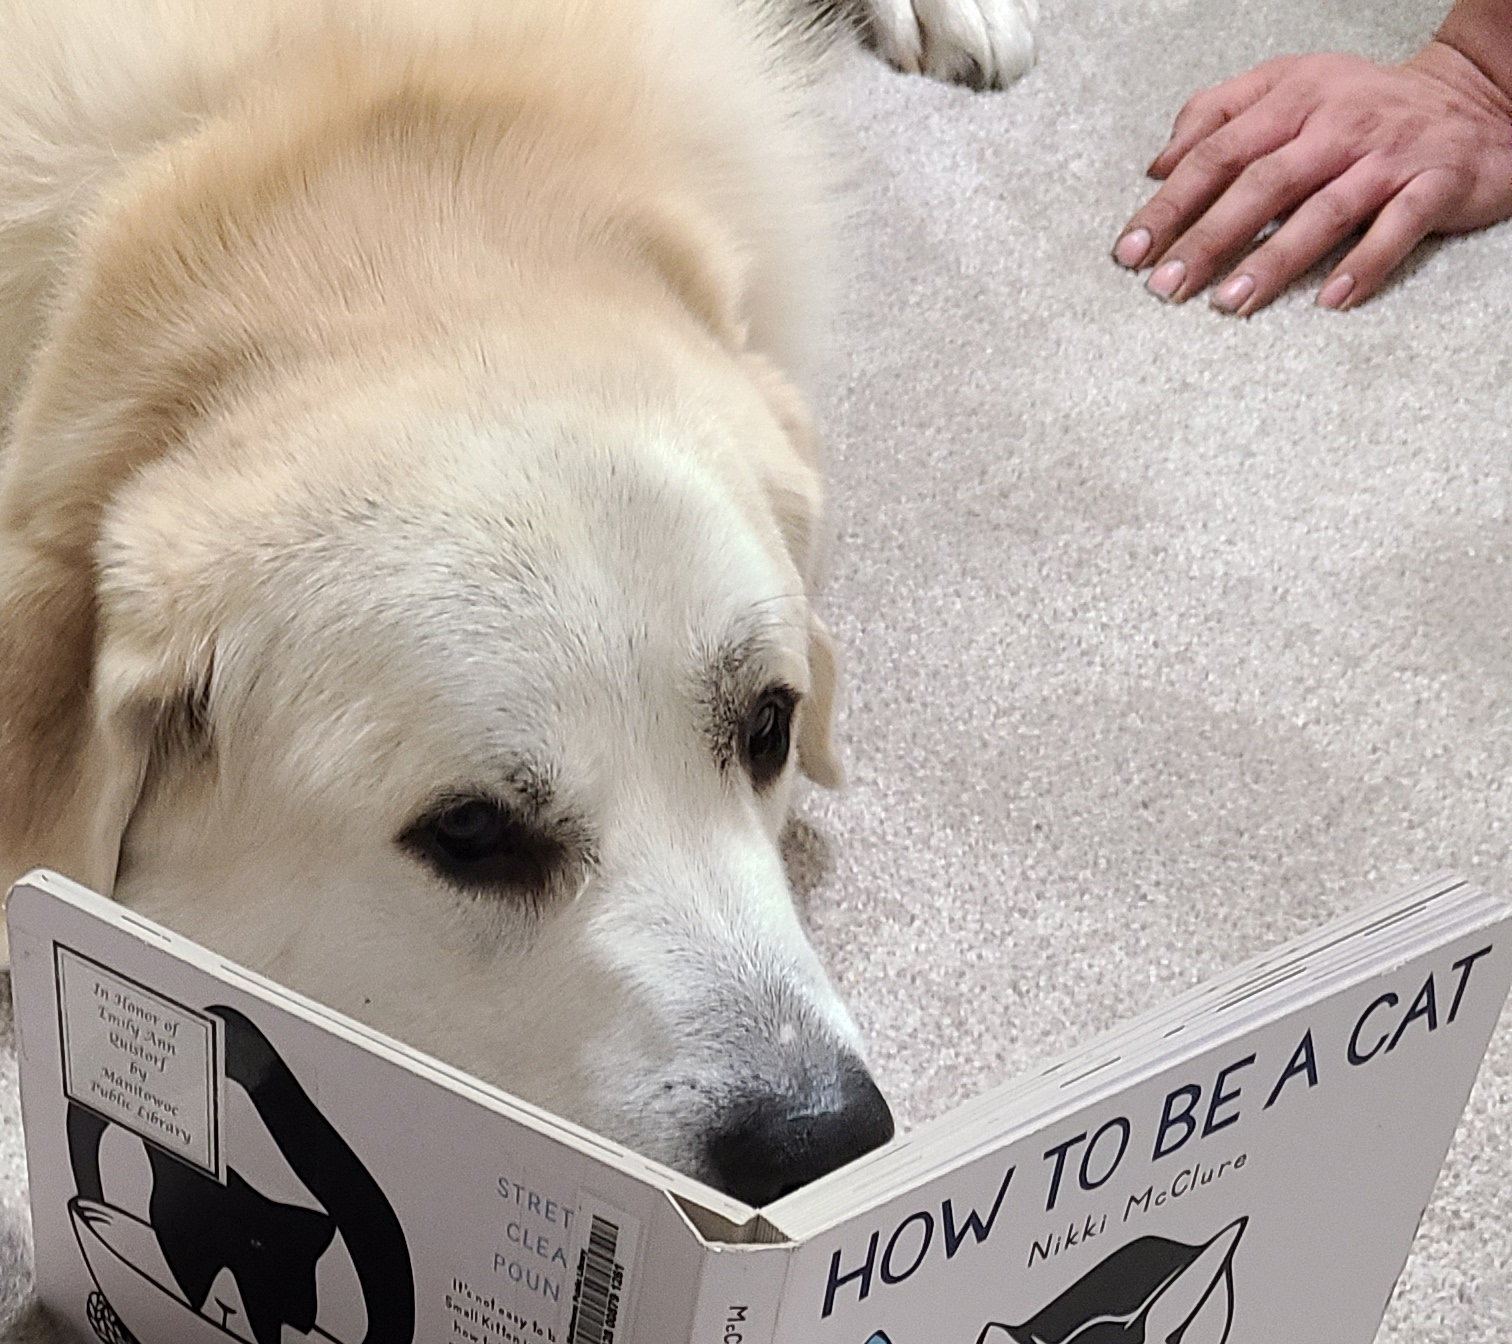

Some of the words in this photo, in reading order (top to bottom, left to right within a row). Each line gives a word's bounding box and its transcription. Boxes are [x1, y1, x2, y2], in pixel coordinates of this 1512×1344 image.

[93, 982, 110, 1001] In
[115, 993, 161, 1026] Honor
[163, 1021, 180, 1039] of
[98, 1005, 140, 1041] Emily
[144, 1031, 177, 1056] Ann
[101, 1067, 179, 1117] Manitowoc
[129, 1061, 148, 1083] by
[90, 1081, 133, 1111] Public
[137, 1105, 193, 1145] Library
[821, 1164, 1018, 1320] HOW
[1043, 1116, 1131, 1212] TO
[1152, 1052, 1257, 1162] BE
[1262, 1026, 1319, 1111] A
[1346, 944, 1494, 1067] CAT
[496, 1176, 577, 1230] STRET
[1028, 1213, 1108, 1269] Nikki
[1122, 1153, 1248, 1223] McClure
[506, 1222, 568, 1270] CLEA
[493, 1252, 561, 1303] POUN
[445, 1294, 479, 1324] Small
[451, 1276, 473, 1300] It's
[475, 1295, 496, 1312] not
[498, 1306, 528, 1331] easy
[532, 1319, 544, 1337] to
[547, 1327, 557, 1343] b
[453, 1319, 479, 1344] how
